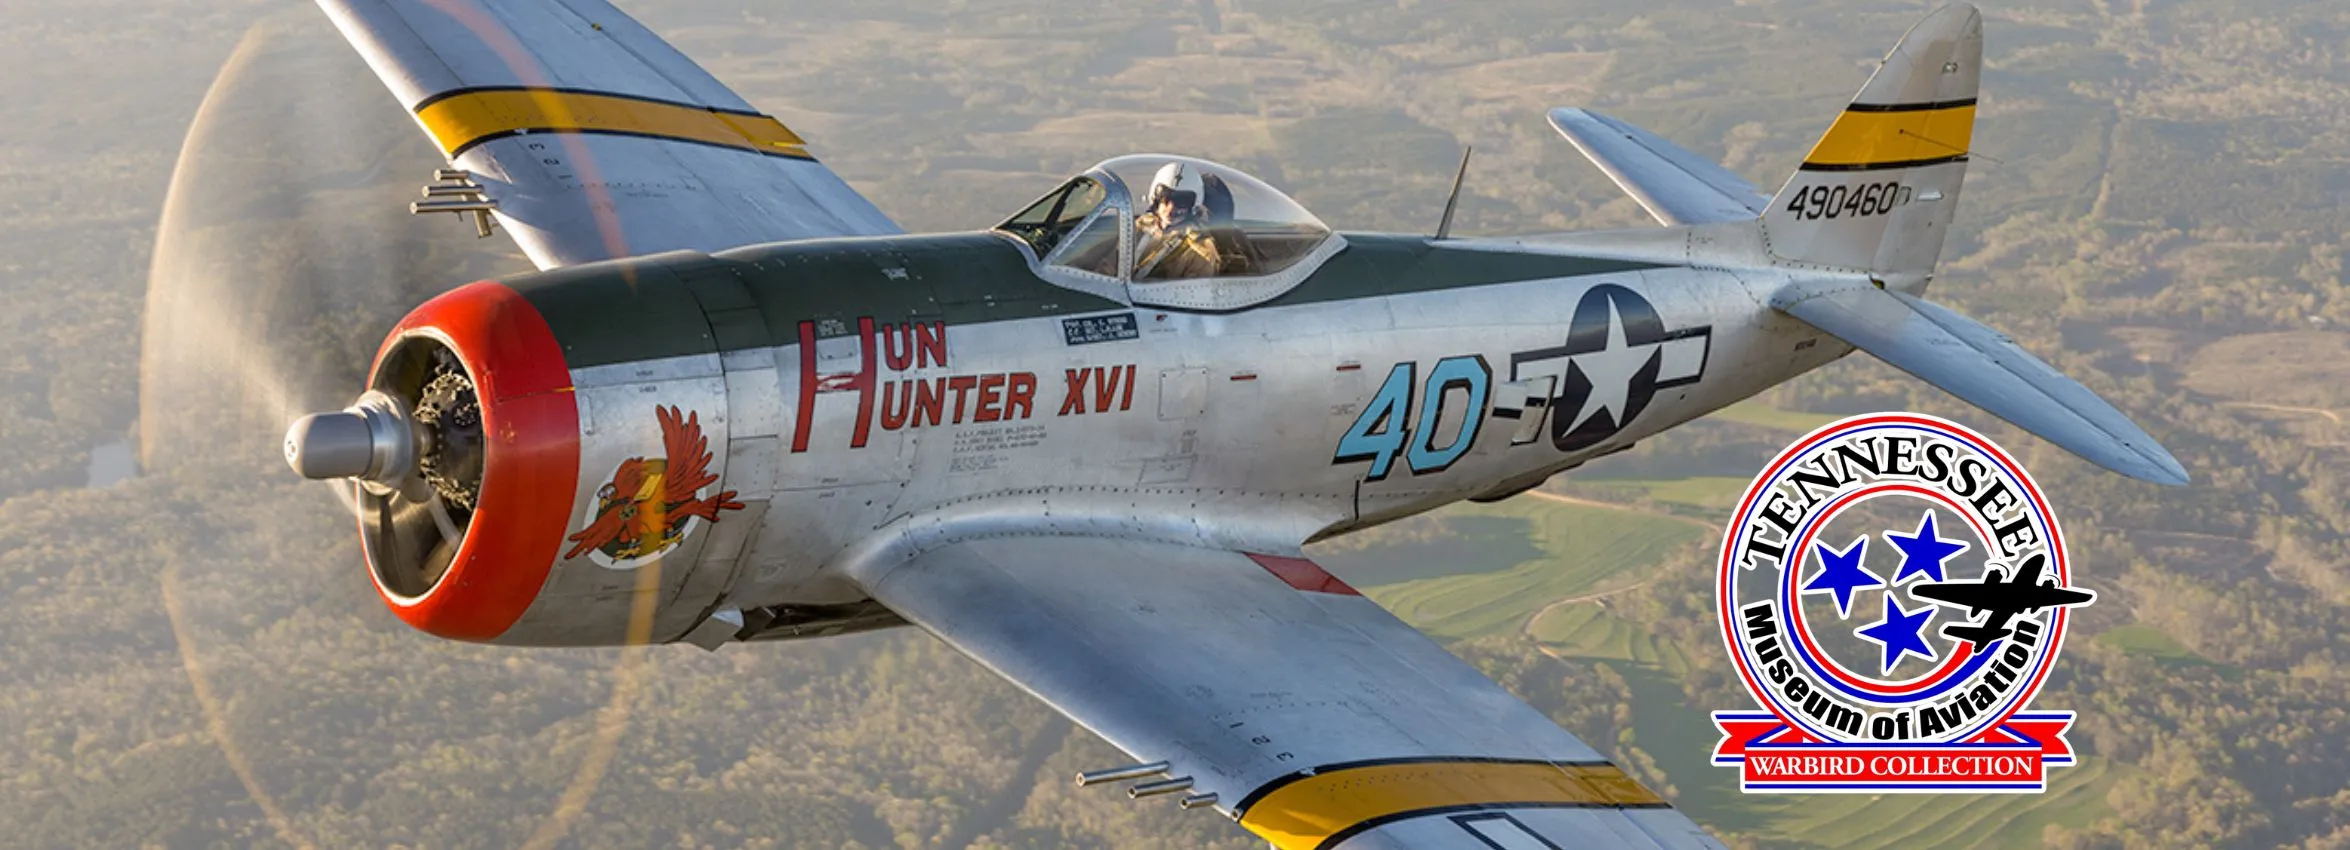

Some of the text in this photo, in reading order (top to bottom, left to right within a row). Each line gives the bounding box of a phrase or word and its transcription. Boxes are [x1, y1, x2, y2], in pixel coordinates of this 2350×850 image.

[1787, 181, 1899, 220] 490460
[1056, 364, 1137, 417] XVI
[1332, 354, 1493, 483] 40
